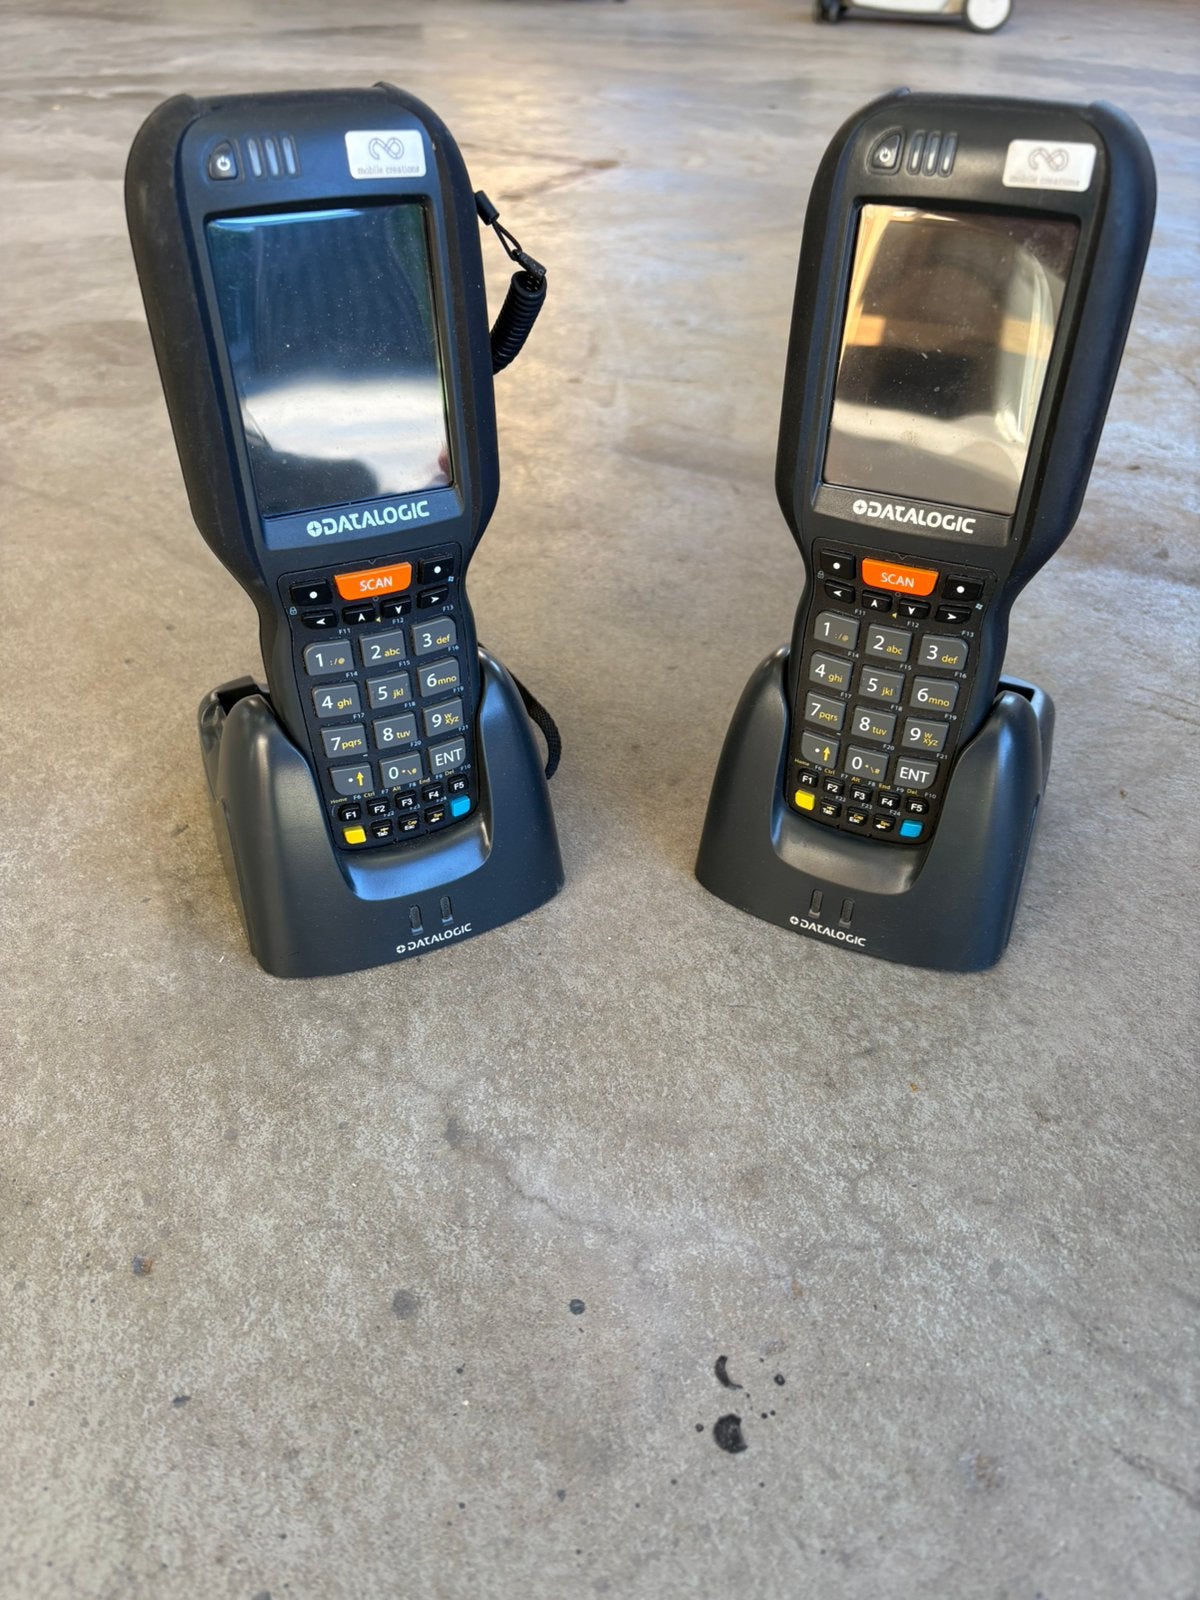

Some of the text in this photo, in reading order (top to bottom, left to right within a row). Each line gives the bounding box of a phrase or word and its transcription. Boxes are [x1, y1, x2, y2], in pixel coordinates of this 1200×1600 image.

[321, 500, 430, 535] DATALOGIC
[866, 501, 977, 534] DATALOGIC
[359, 576, 393, 592] SCAN
[880, 572, 915, 588] SCAN
[436, 633, 450, 645] def
[384, 647, 401, 658] abc
[886, 645, 903, 655] abc
[941, 654, 959, 664] def
[828, 671, 843, 683] ghi
[881, 686, 893, 697] jkl
[435, 748, 463, 766] ENT
[802, 775, 813, 784] F1
[899, 766, 930, 783] ENT
[453, 781, 465, 791] F5
[826, 783, 839, 793] F2
[428, 791, 439, 800] F4
[854, 791, 866, 800] F3
[401, 797, 413, 807] F3
[881, 798, 893, 807] F4
[374, 805, 386, 814] F2
[910, 803, 923, 812] F5
[345, 811, 357, 820] F1
[407, 922, 472, 951] DATALOGIC
[800, 918, 867, 947] DATALOGIC
